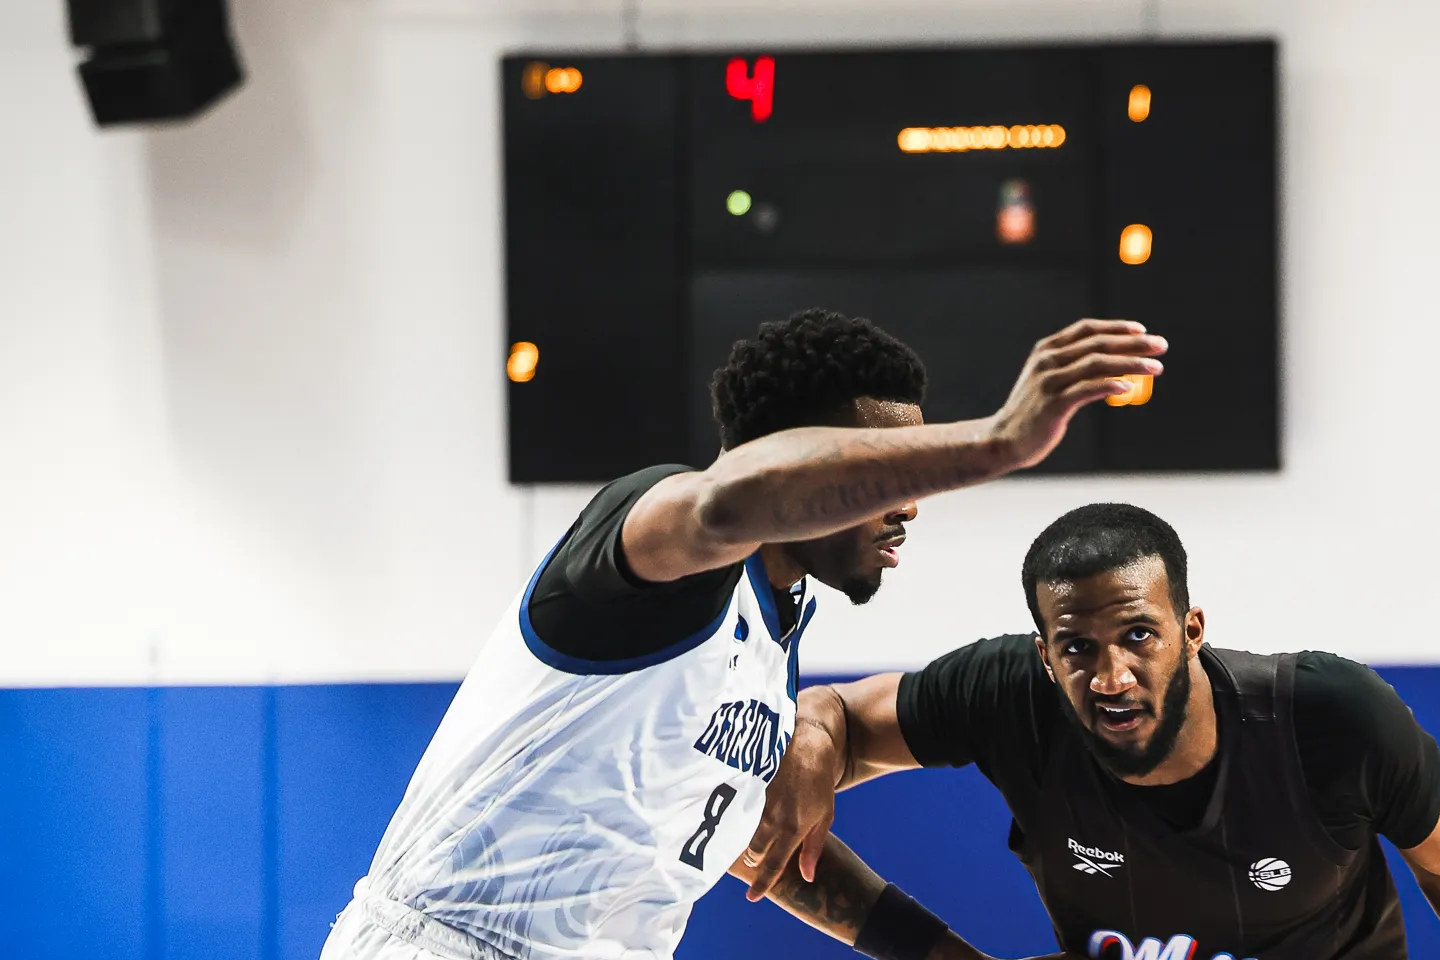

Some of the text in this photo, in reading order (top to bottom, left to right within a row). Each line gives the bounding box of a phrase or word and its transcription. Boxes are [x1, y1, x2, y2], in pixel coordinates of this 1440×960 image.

[679, 782, 737, 872] 8
[1067, 837, 1125, 863] Reebok
[1259, 866, 1292, 880] SLB
